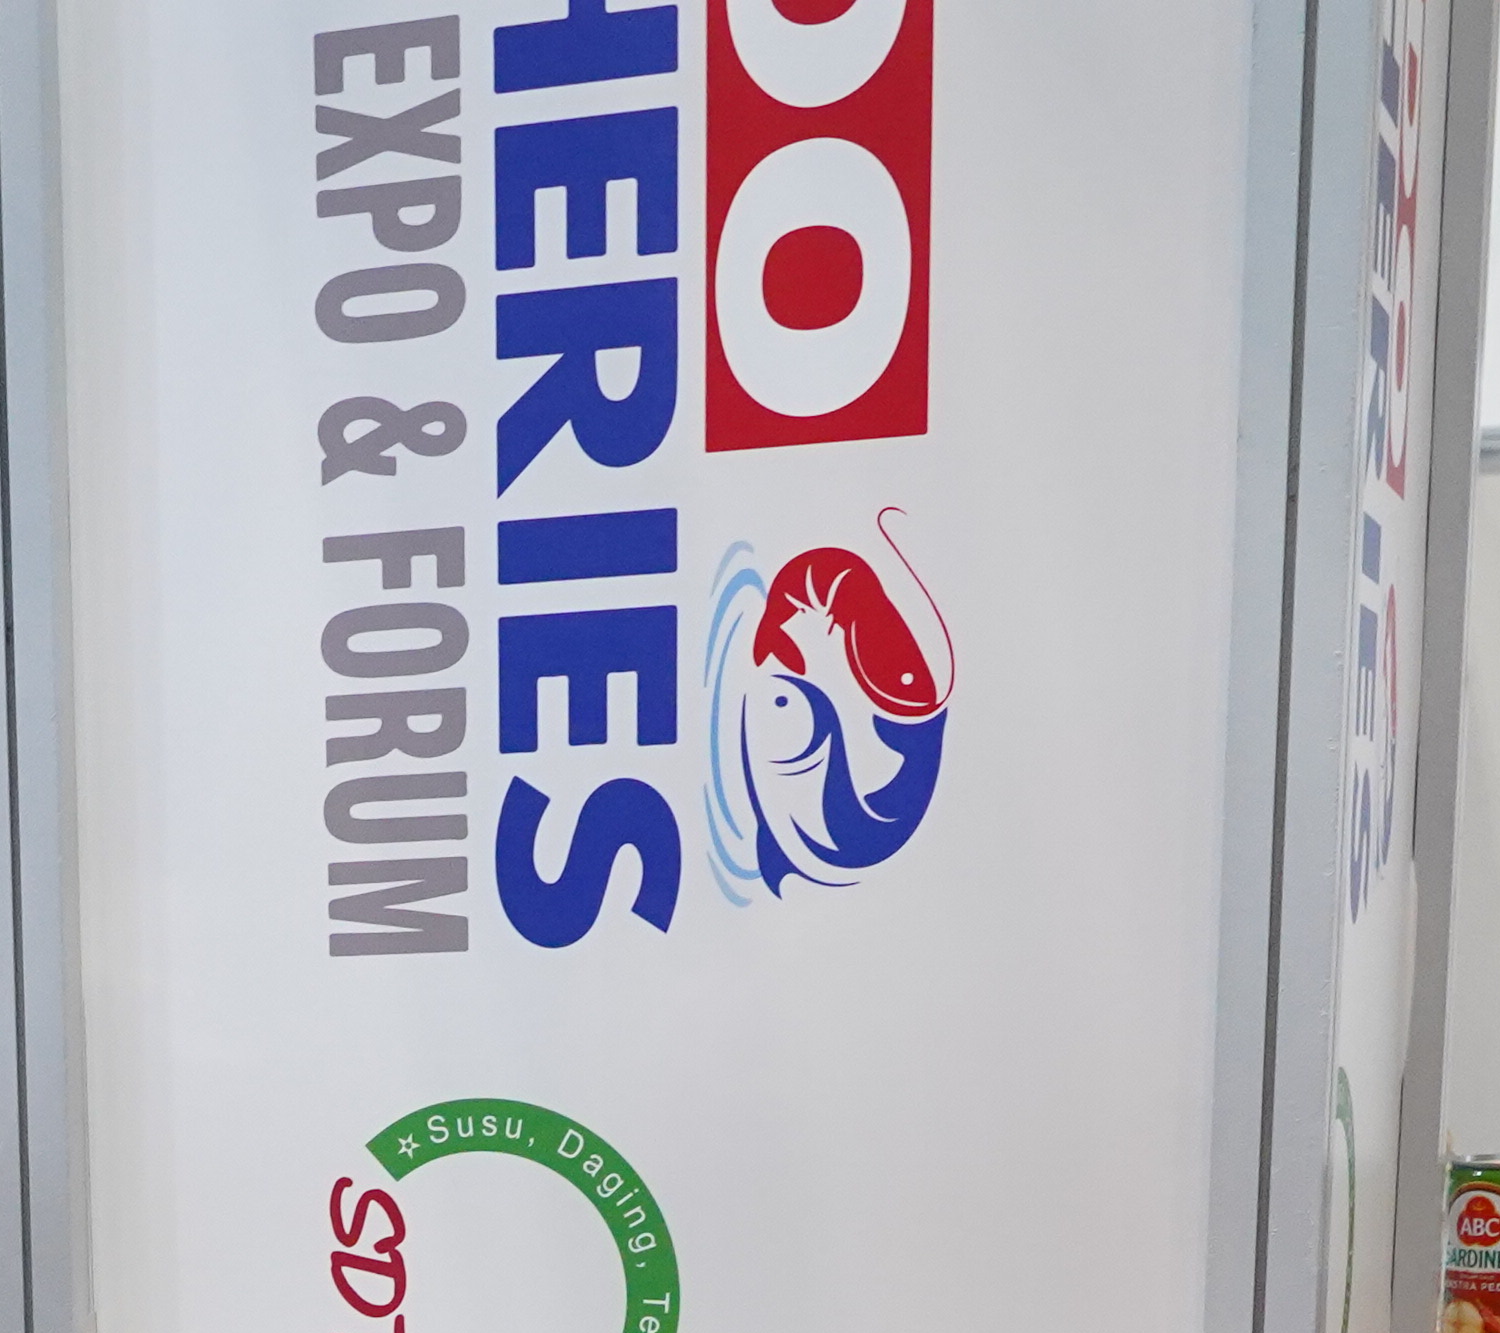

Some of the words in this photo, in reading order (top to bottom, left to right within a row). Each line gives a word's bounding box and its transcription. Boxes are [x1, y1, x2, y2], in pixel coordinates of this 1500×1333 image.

[313, 14, 467, 345] EXPO
[315, 395, 468, 487] &
[320, 525, 470, 958] FORUM
[426, 1113, 536, 1148] Susu,
[556, 1128, 657, 1269] Daging,
[1459, 1217, 1500, 1238] ABC
